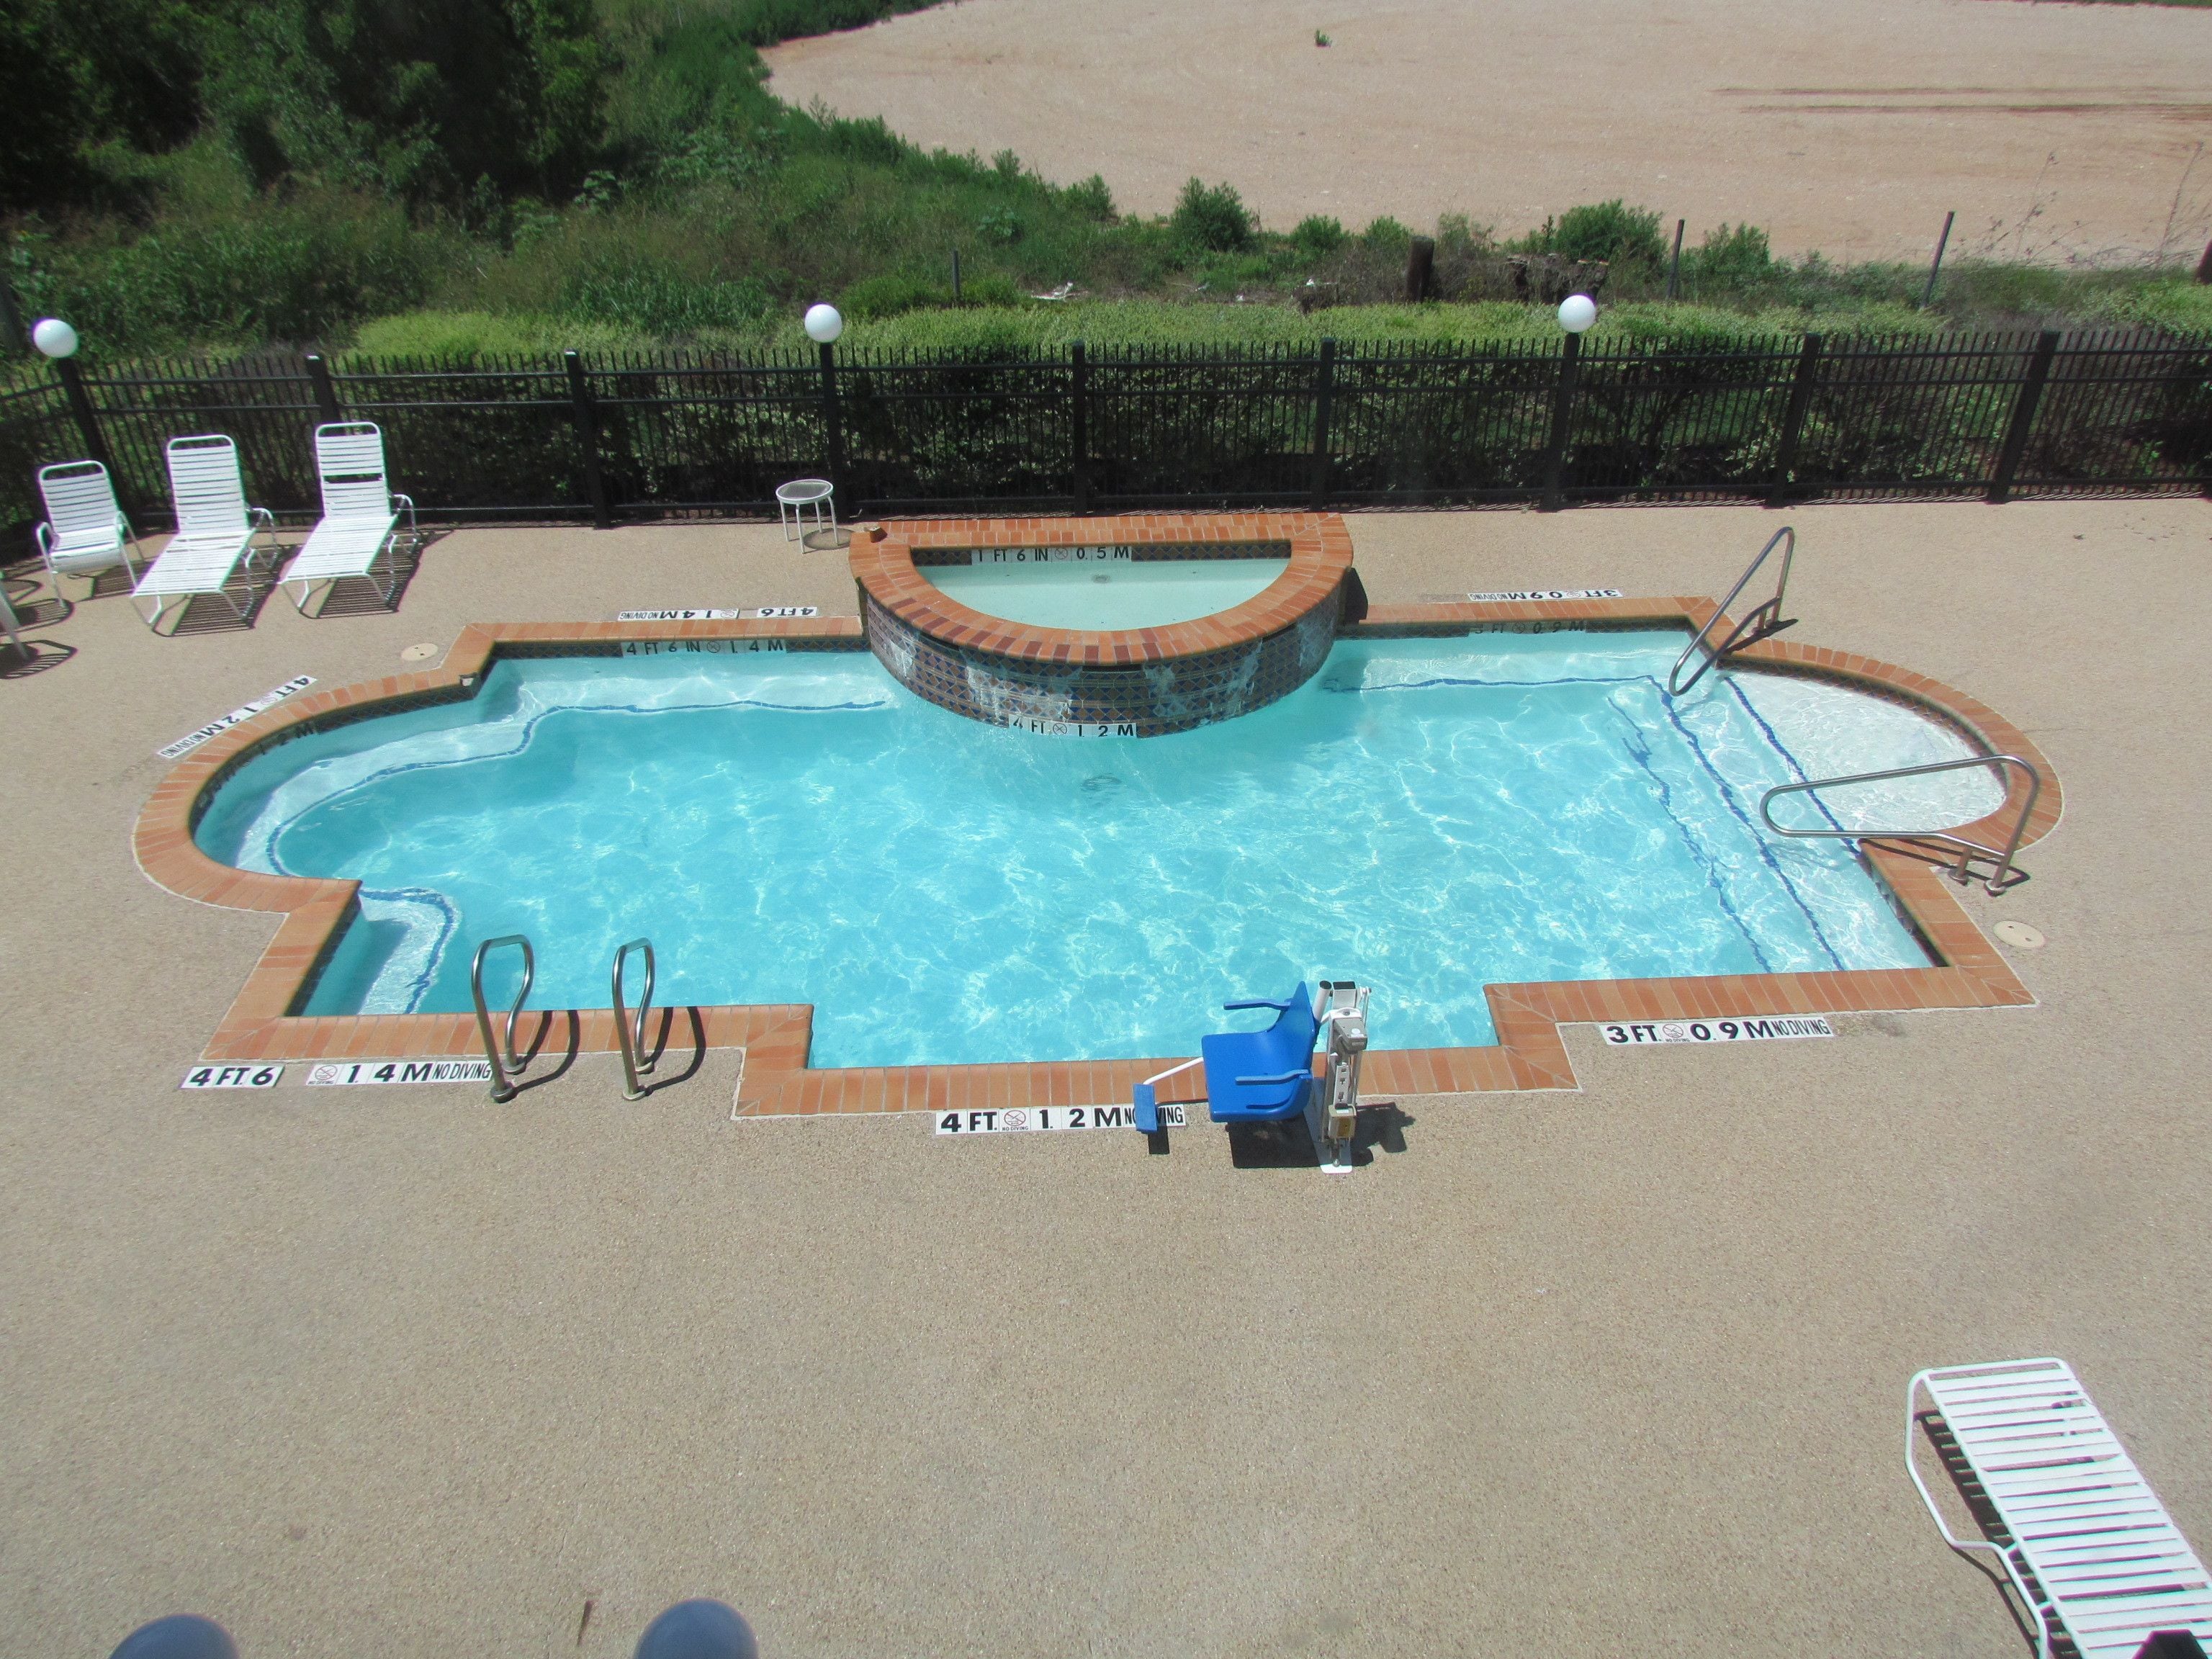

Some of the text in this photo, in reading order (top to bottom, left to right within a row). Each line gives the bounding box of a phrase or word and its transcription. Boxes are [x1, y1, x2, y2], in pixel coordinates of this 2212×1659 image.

[1770, 1020, 1790, 1035] NO
[1786, 1019, 1831, 1035] DIVING
[432, 1063, 451, 1079] NO
[449, 1063, 492, 1079] DIVING
